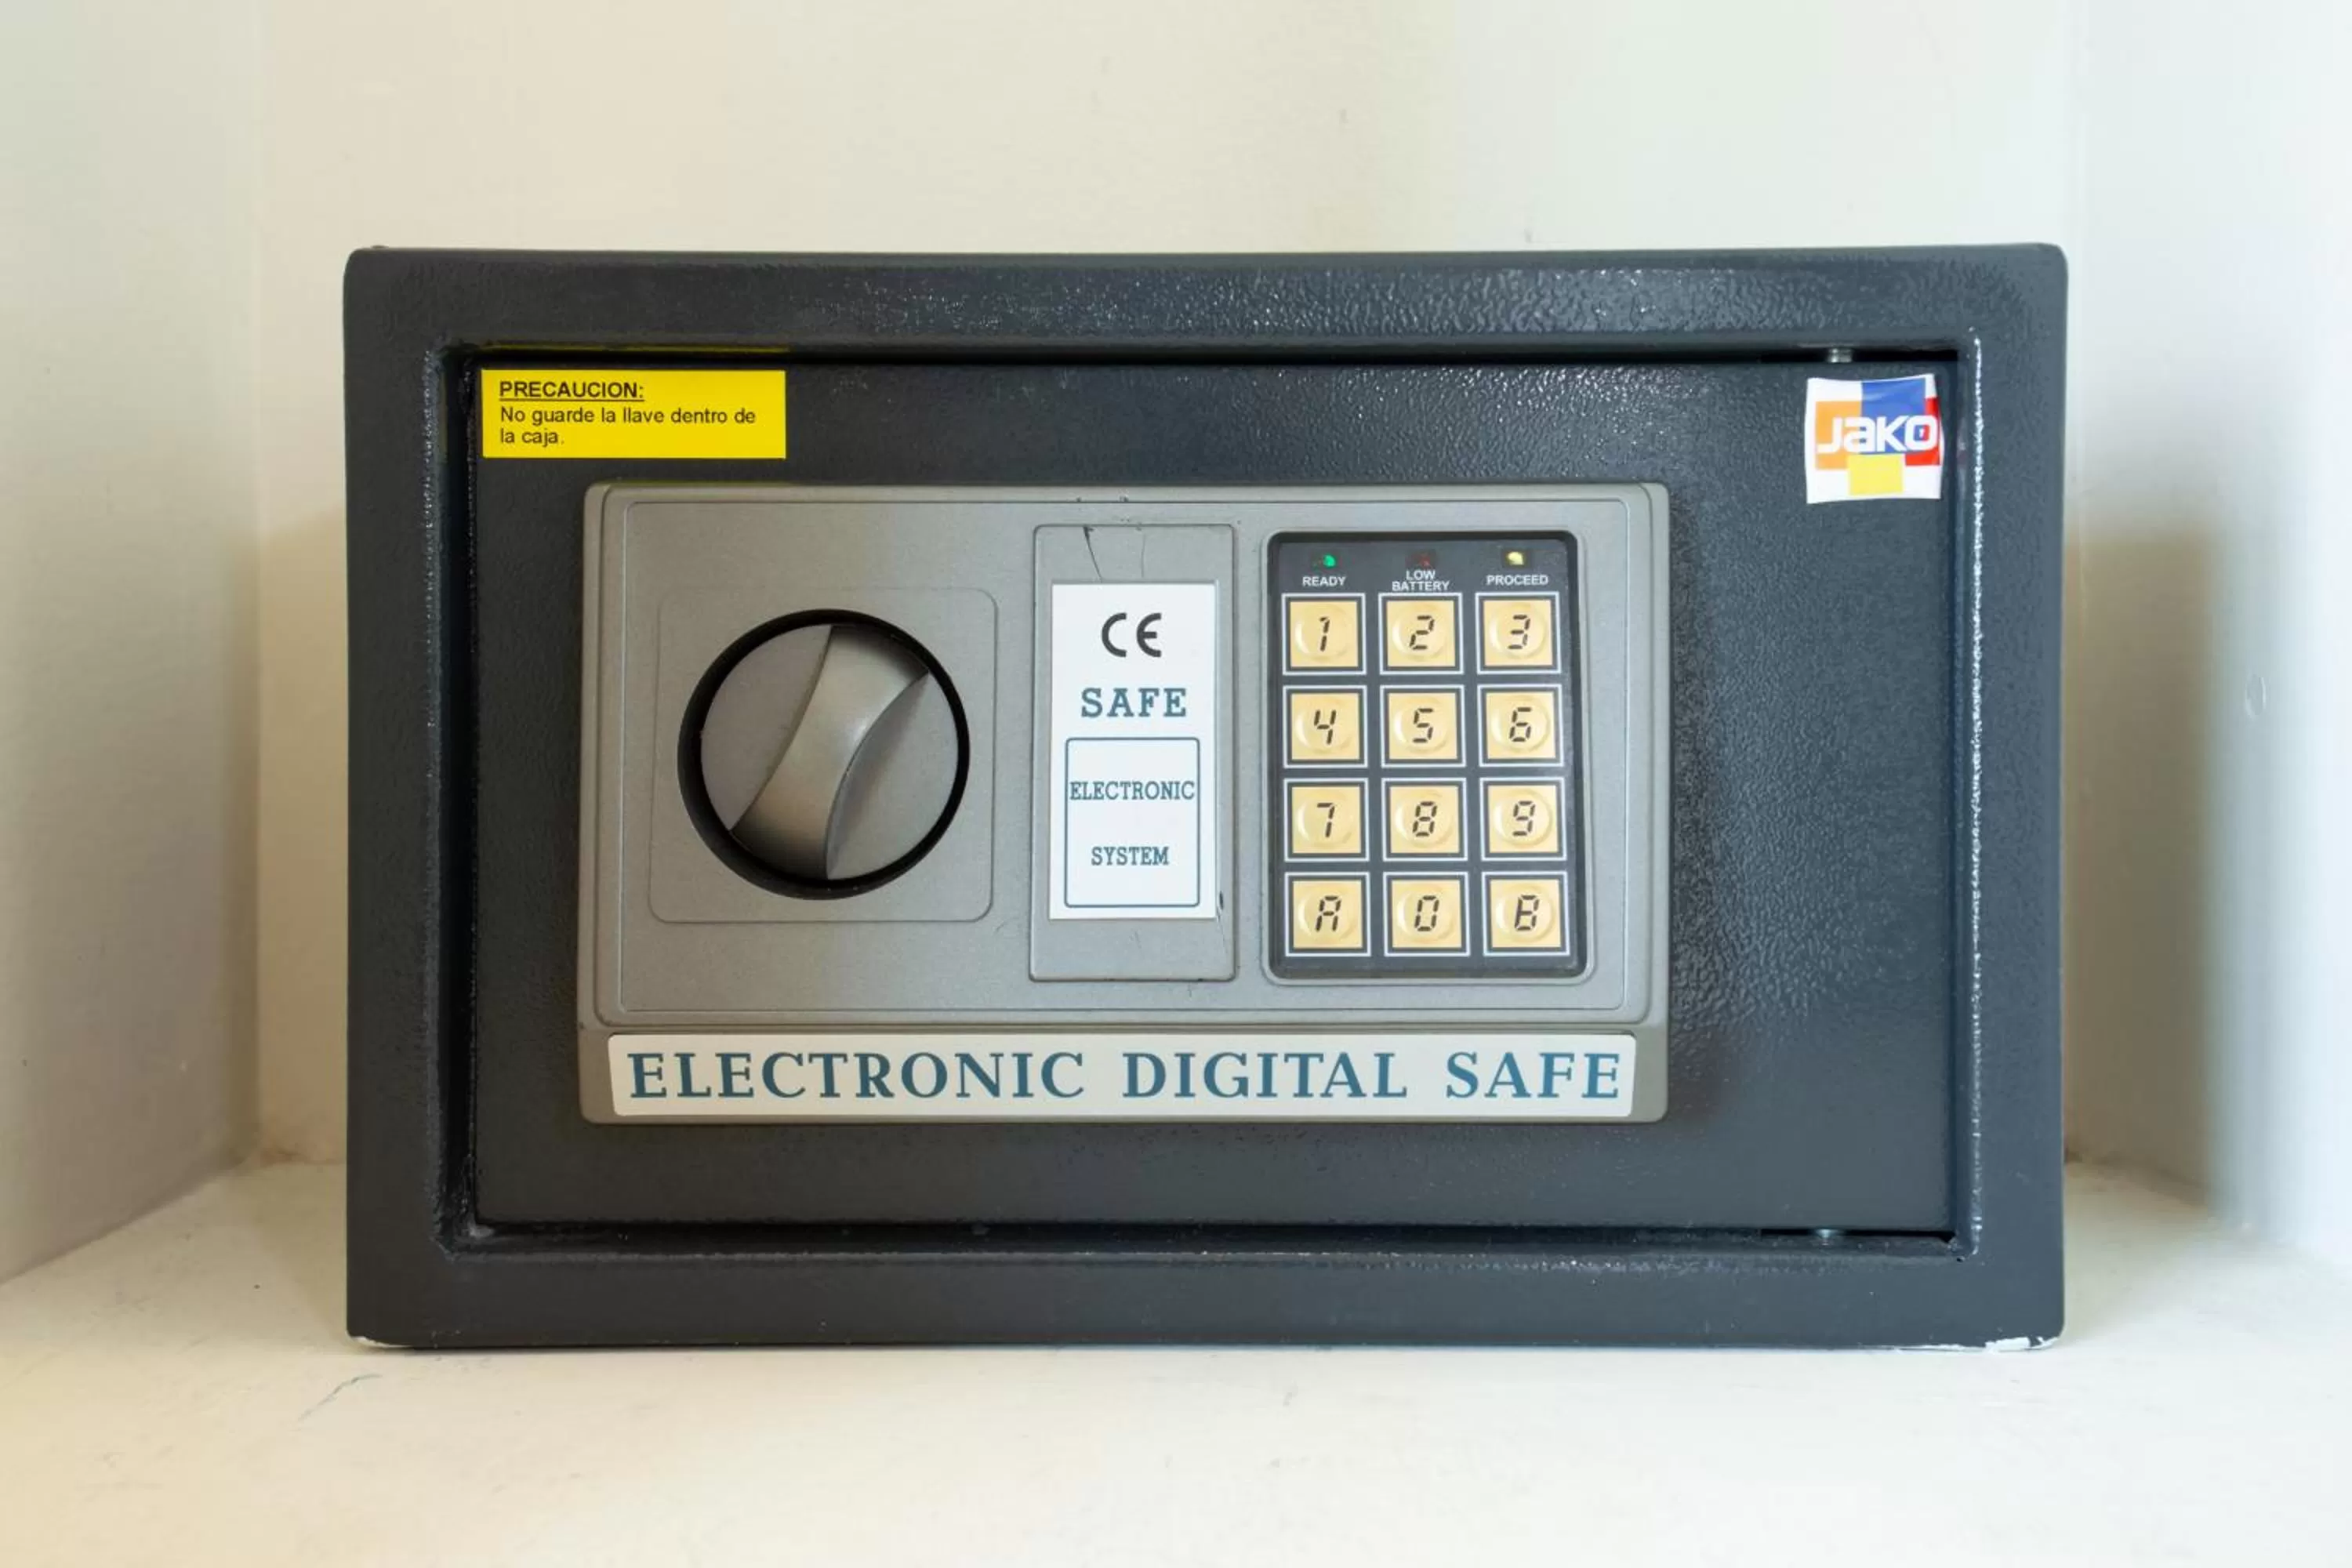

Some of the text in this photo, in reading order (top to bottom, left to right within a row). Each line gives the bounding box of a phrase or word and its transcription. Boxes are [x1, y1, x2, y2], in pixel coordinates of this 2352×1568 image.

[499, 381, 644, 401] PRECAUCION:
[500, 407, 756, 426] No guarde la llave dentro de
[500, 428, 564, 448] la caja.
[1301, 575, 1347, 587] READY
[1392, 580, 1450, 592] BATTERY
[1406, 570, 1436, 581] LOW
[1486, 575, 1548, 586] PROCEED
[1102, 612, 1162, 658] CE
[1319, 616, 1330, 652] 1
[1409, 615, 1435, 651] 2
[1508, 614, 1531, 650] 3
[1081, 688, 1187, 719] SAFE
[1313, 710, 1337, 746] 4
[1412, 708, 1434, 744] 5
[1509, 706, 1532, 743] 6
[1069, 781, 1196, 800] ELECTRONIC
[1316, 802, 1336, 839] 7
[1412, 801, 1438, 837] 8
[1512, 800, 1536, 837] 9
[1091, 847, 1170, 866] SYSTEM
[1315, 895, 1342, 932] A
[1414, 895, 1439, 932] 0
[1514, 895, 1540, 931] B
[627, 1052, 1621, 1098] ELECTRONIC DIGITAL SAFE
